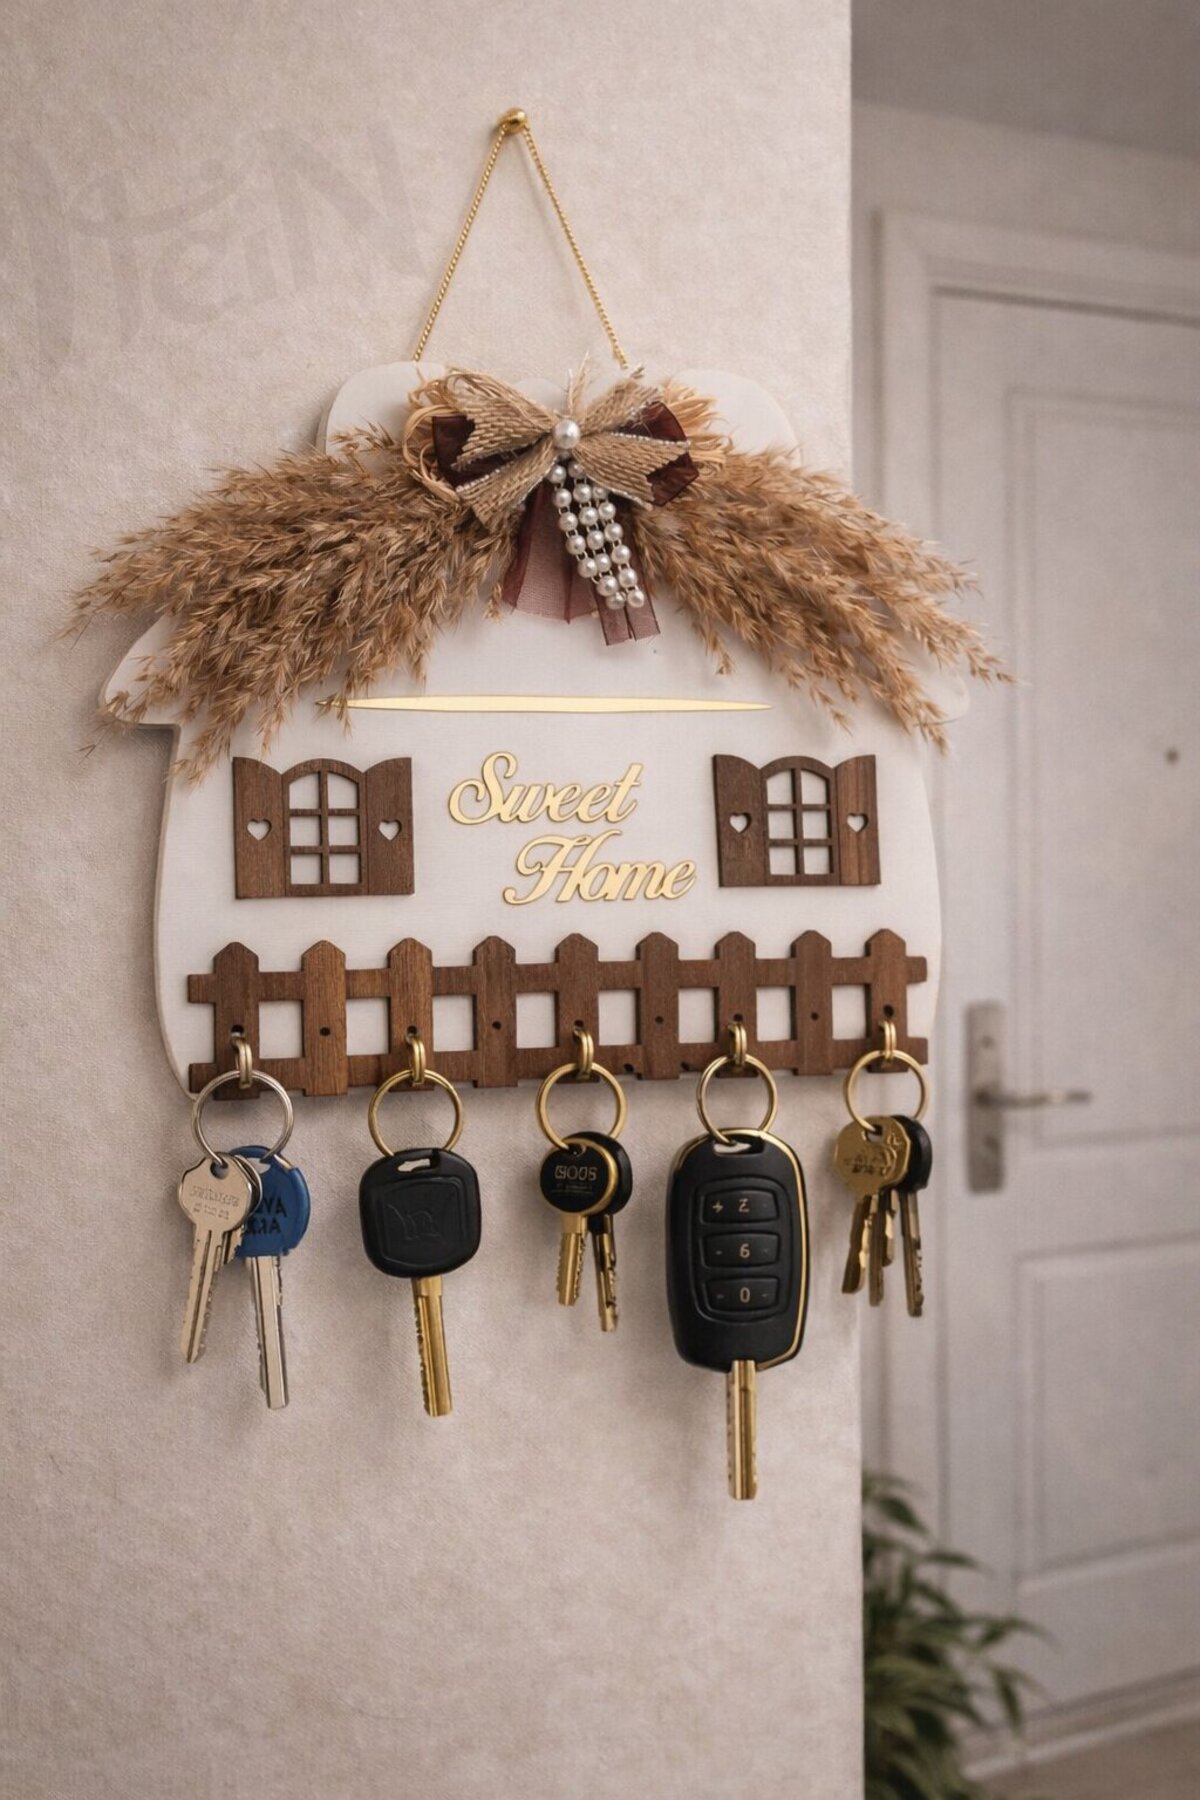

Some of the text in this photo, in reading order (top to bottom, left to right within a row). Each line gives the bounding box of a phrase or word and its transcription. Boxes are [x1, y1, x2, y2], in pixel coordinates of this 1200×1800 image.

[448, 751, 644, 825] Sweet
[503, 829, 696, 905] Home
[739, 1243, 751, 1259] 6
